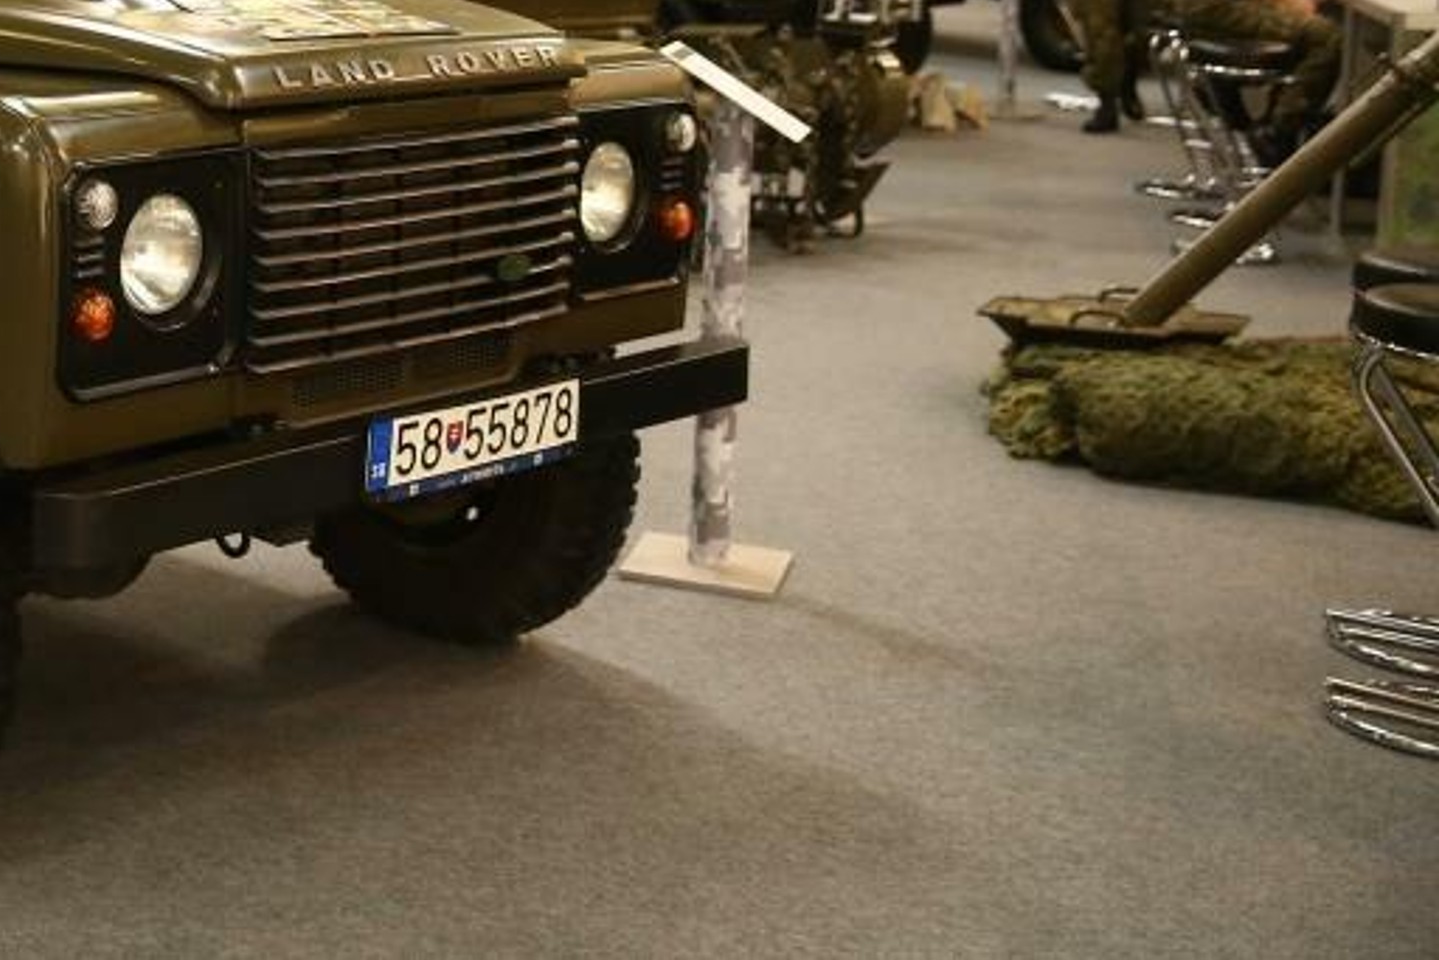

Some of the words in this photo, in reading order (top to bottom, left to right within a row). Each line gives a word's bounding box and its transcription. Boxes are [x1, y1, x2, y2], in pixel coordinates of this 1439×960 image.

[271, 59, 396, 89] LAND
[426, 43, 561, 77] ROVER
[394, 416, 444, 476] 58
[462, 387, 573, 461] 55878
